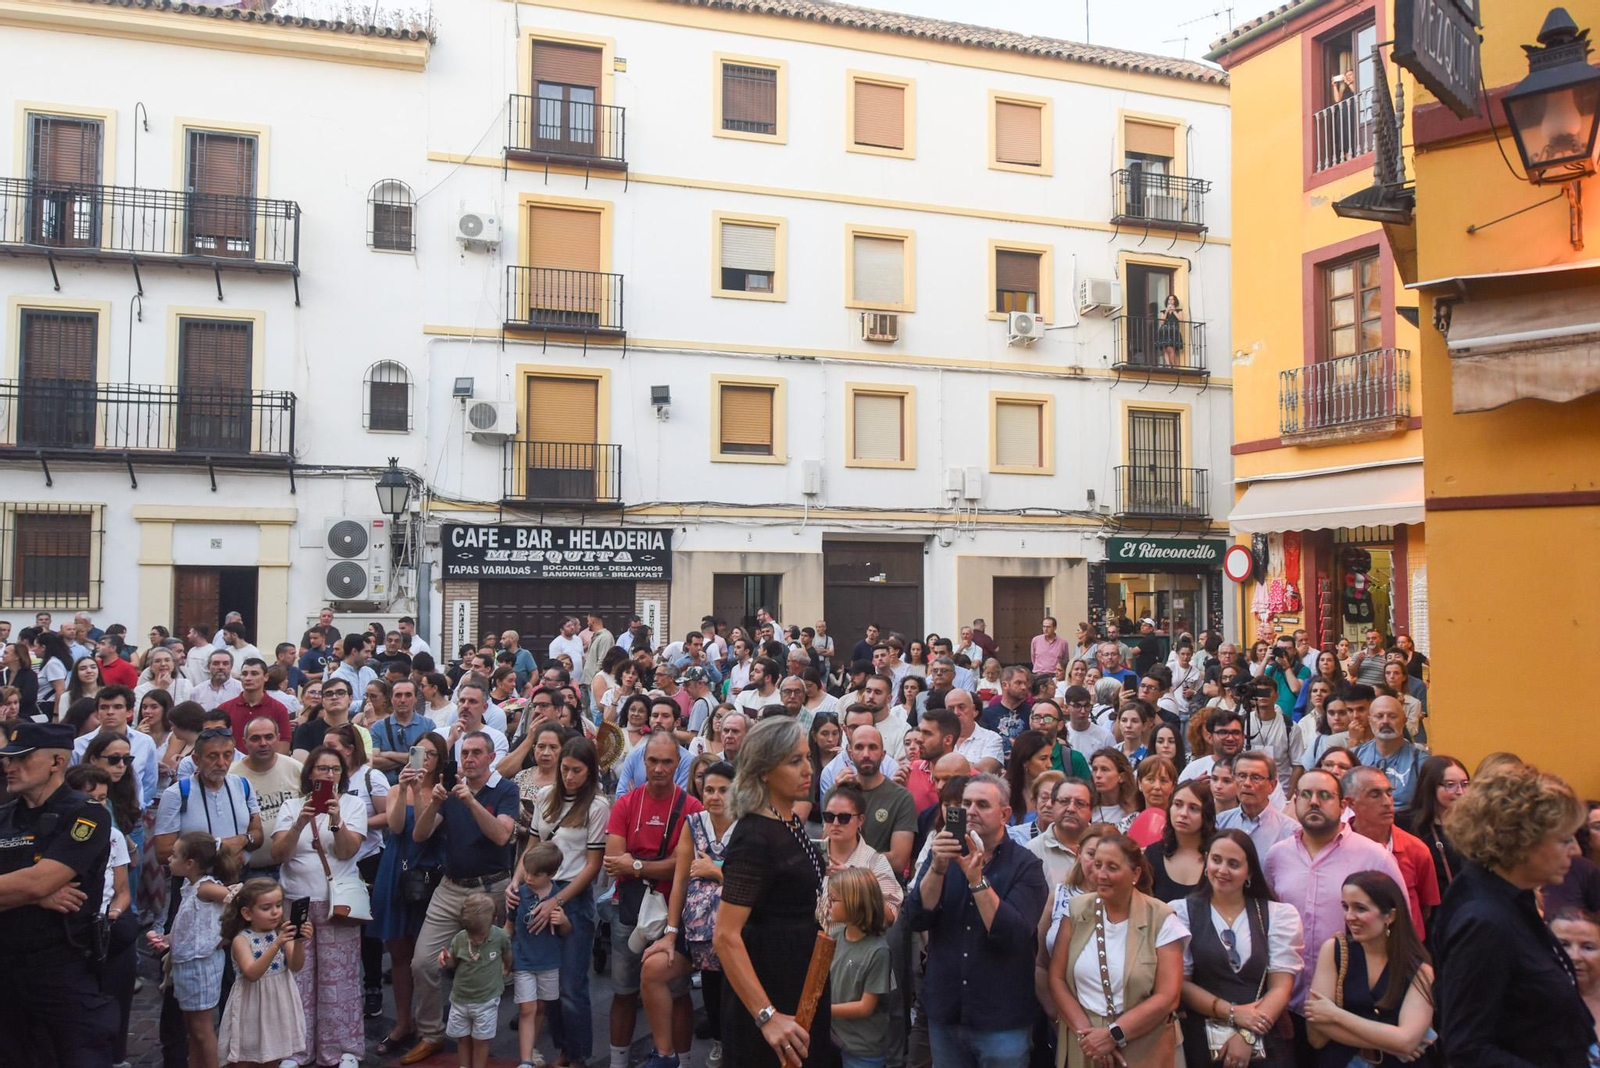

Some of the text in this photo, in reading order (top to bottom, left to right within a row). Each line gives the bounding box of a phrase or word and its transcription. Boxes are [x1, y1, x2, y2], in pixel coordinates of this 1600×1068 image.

[451, 527, 499, 548] CAFE
[516, 528, 553, 549] BAR
[569, 529, 665, 550] HELADERIA
[483, 549, 633, 564] MEZQUITA
[1119, 542, 1217, 559] El Rinconcillo
[448, 565, 479, 574] TAPAS
[481, 565, 531, 575] VARIADAS
